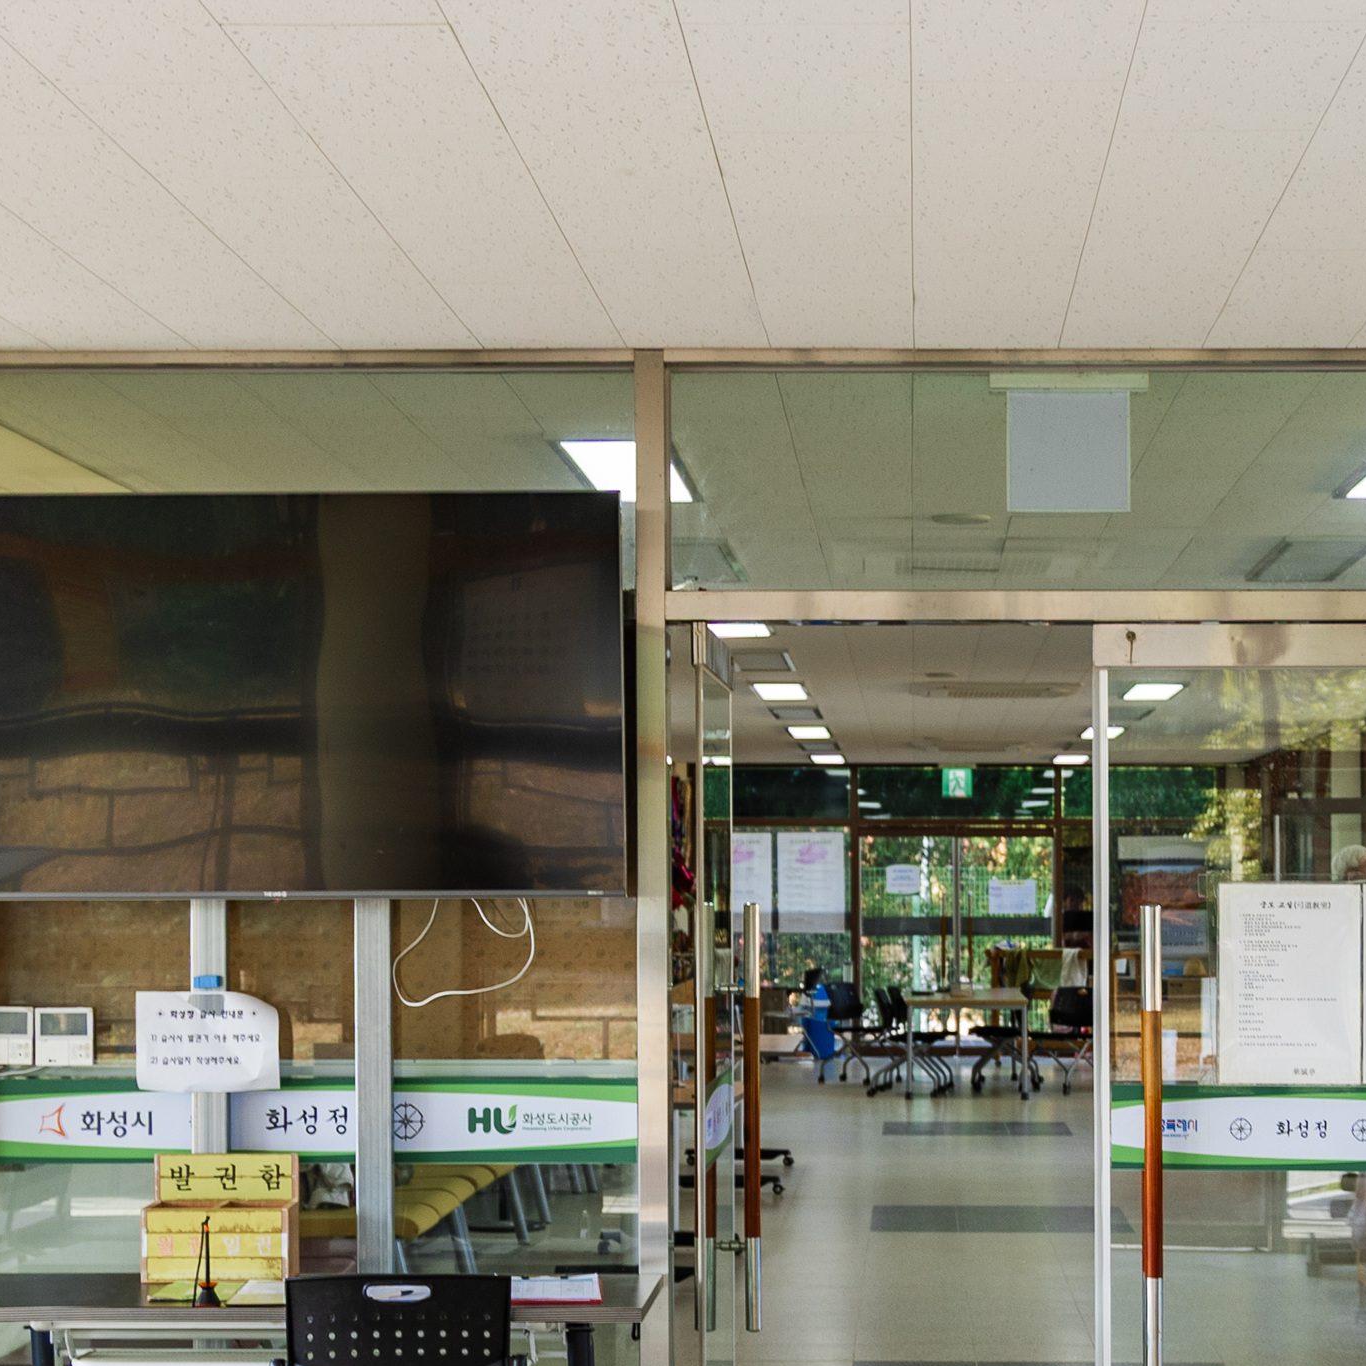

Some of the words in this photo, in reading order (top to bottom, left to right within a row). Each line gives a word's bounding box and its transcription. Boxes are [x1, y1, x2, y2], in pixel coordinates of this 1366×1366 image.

[80, 1110, 153, 1138] 화성시
[265, 1104, 349, 1135] 화성정
[468, 1104, 517, 1135] HU
[522, 1113, 592, 1126] 화성도시공사
[1276, 1119, 1328, 1138] 화성정
